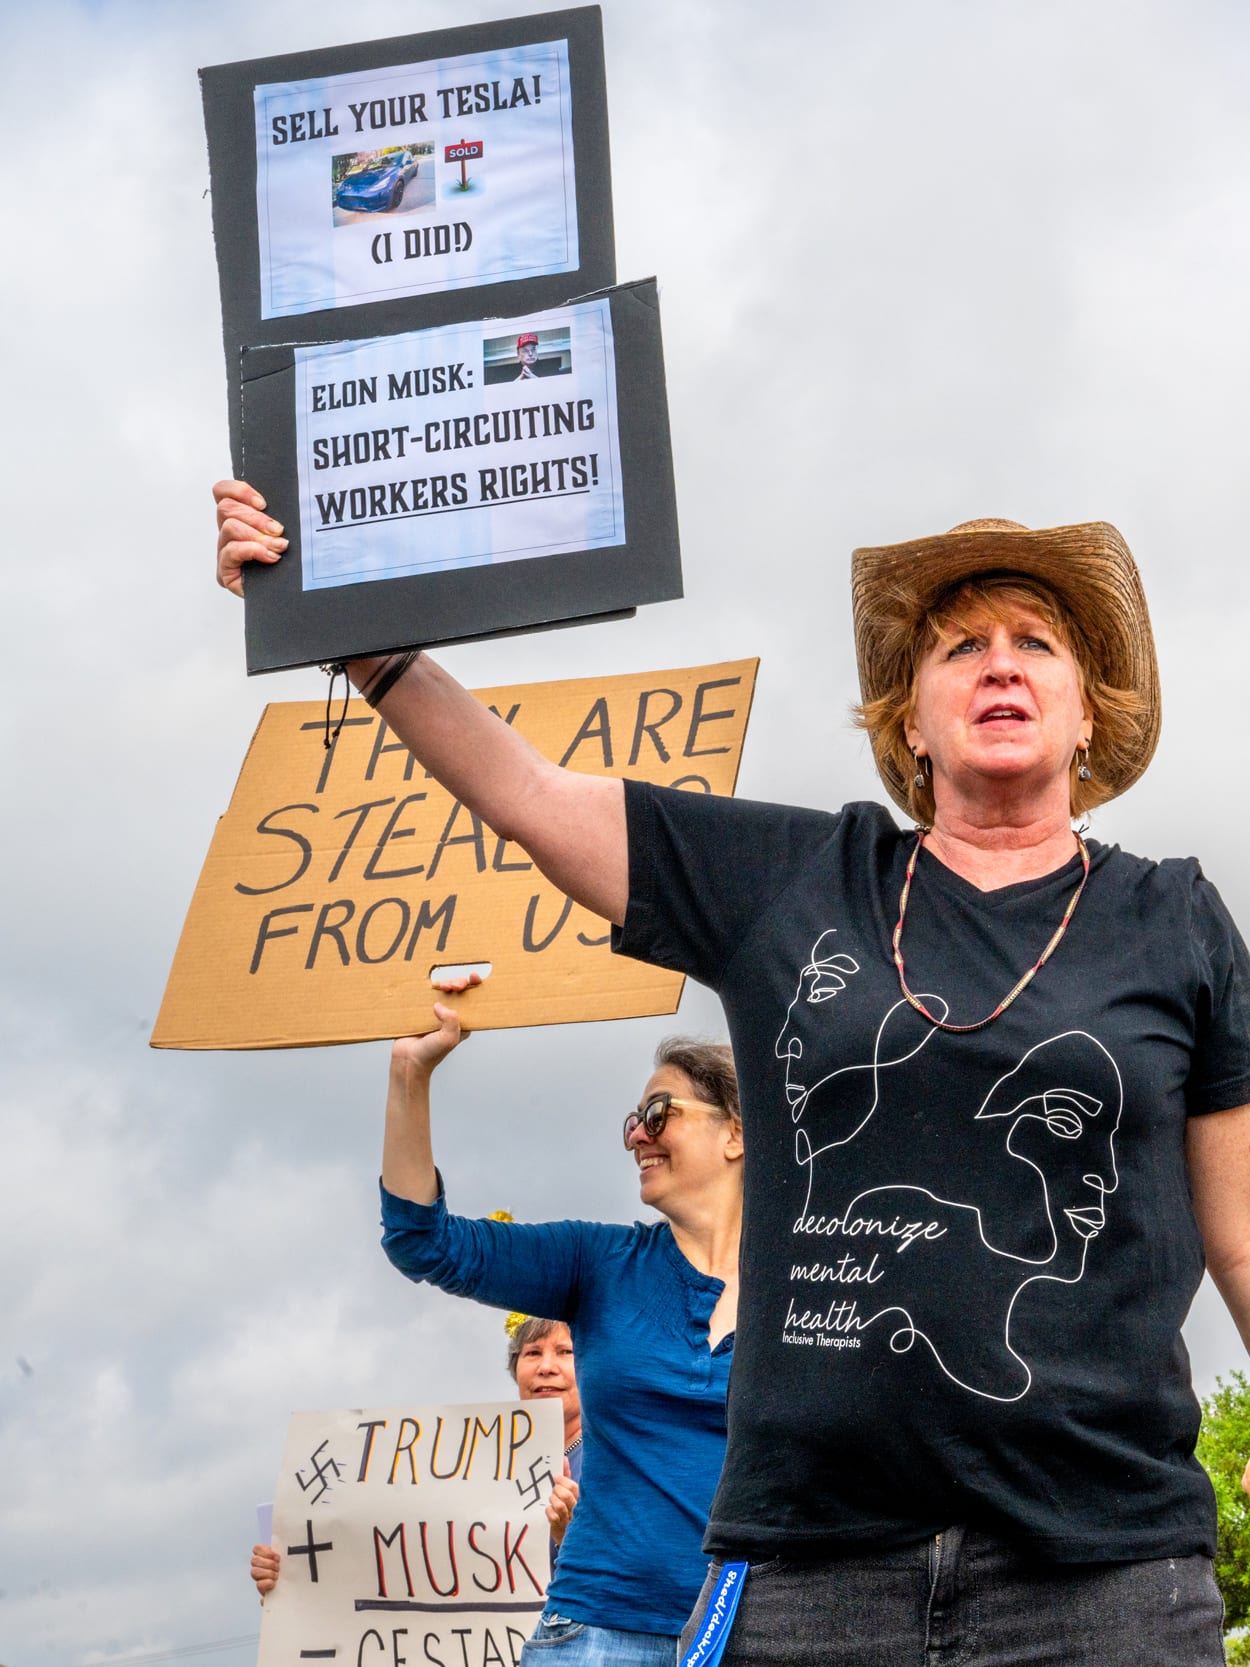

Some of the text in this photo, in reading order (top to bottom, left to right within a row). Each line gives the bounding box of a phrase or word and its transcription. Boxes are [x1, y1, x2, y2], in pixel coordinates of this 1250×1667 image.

[273, 75, 541, 145] SELL YOUR TESLA!
[450, 145, 479, 159] SOLD
[371, 222, 473, 264] (I DID!)
[311, 363, 473, 412] ELON MUSK:
[313, 399, 595, 470] SHORT-CIRCUITING
[315, 454, 599, 525] WORKERS RIGHTS!
[560, 677, 742, 767] ARE
[249, 894, 457, 974] FROM
[792, 1212, 948, 1253] decolonize
[790, 1253, 884, 1283] mental
[782, 1331, 861, 1351] Inclusive Therapists
[784, 1298, 865, 1332] health
[357, 1409, 532, 1484] TRUMP
[373, 1520, 544, 1597] MUSK
